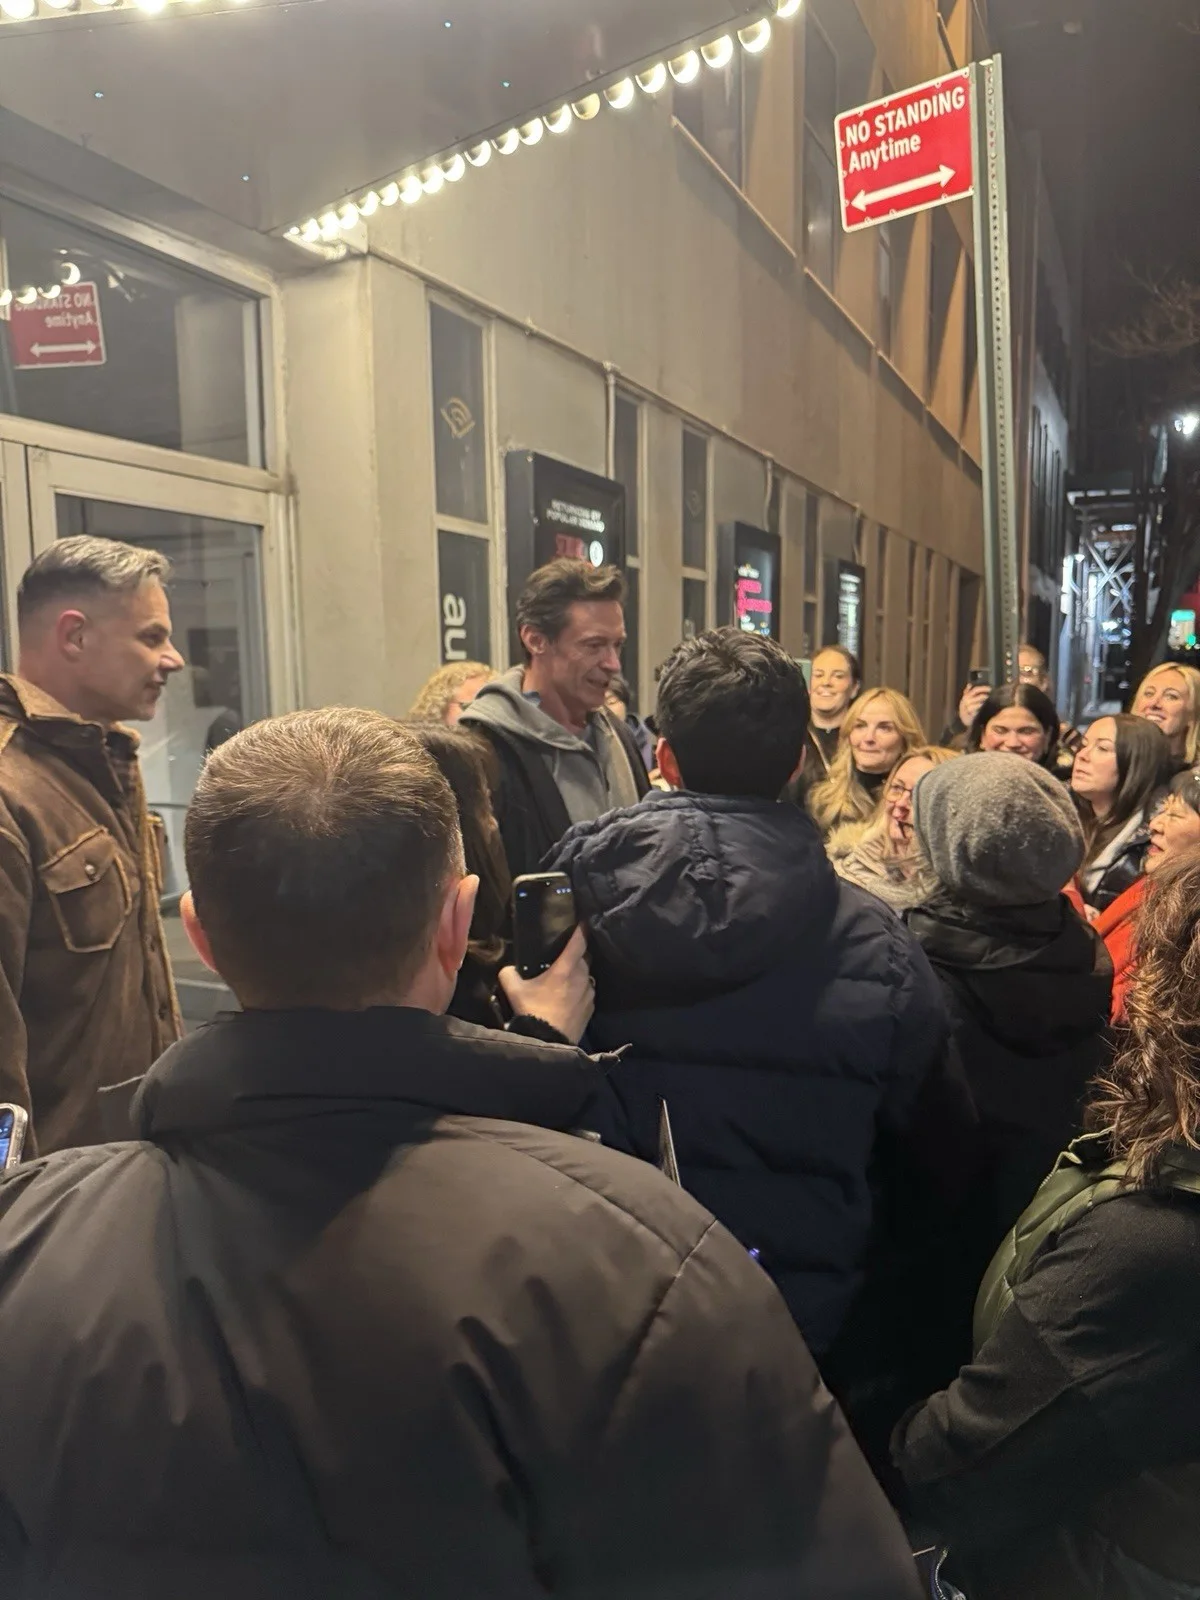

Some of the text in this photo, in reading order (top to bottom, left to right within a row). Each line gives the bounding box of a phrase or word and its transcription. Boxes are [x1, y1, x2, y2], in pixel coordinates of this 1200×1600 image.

[846, 86, 965, 147] NO STANDING
[849, 134, 921, 173] Anytime
